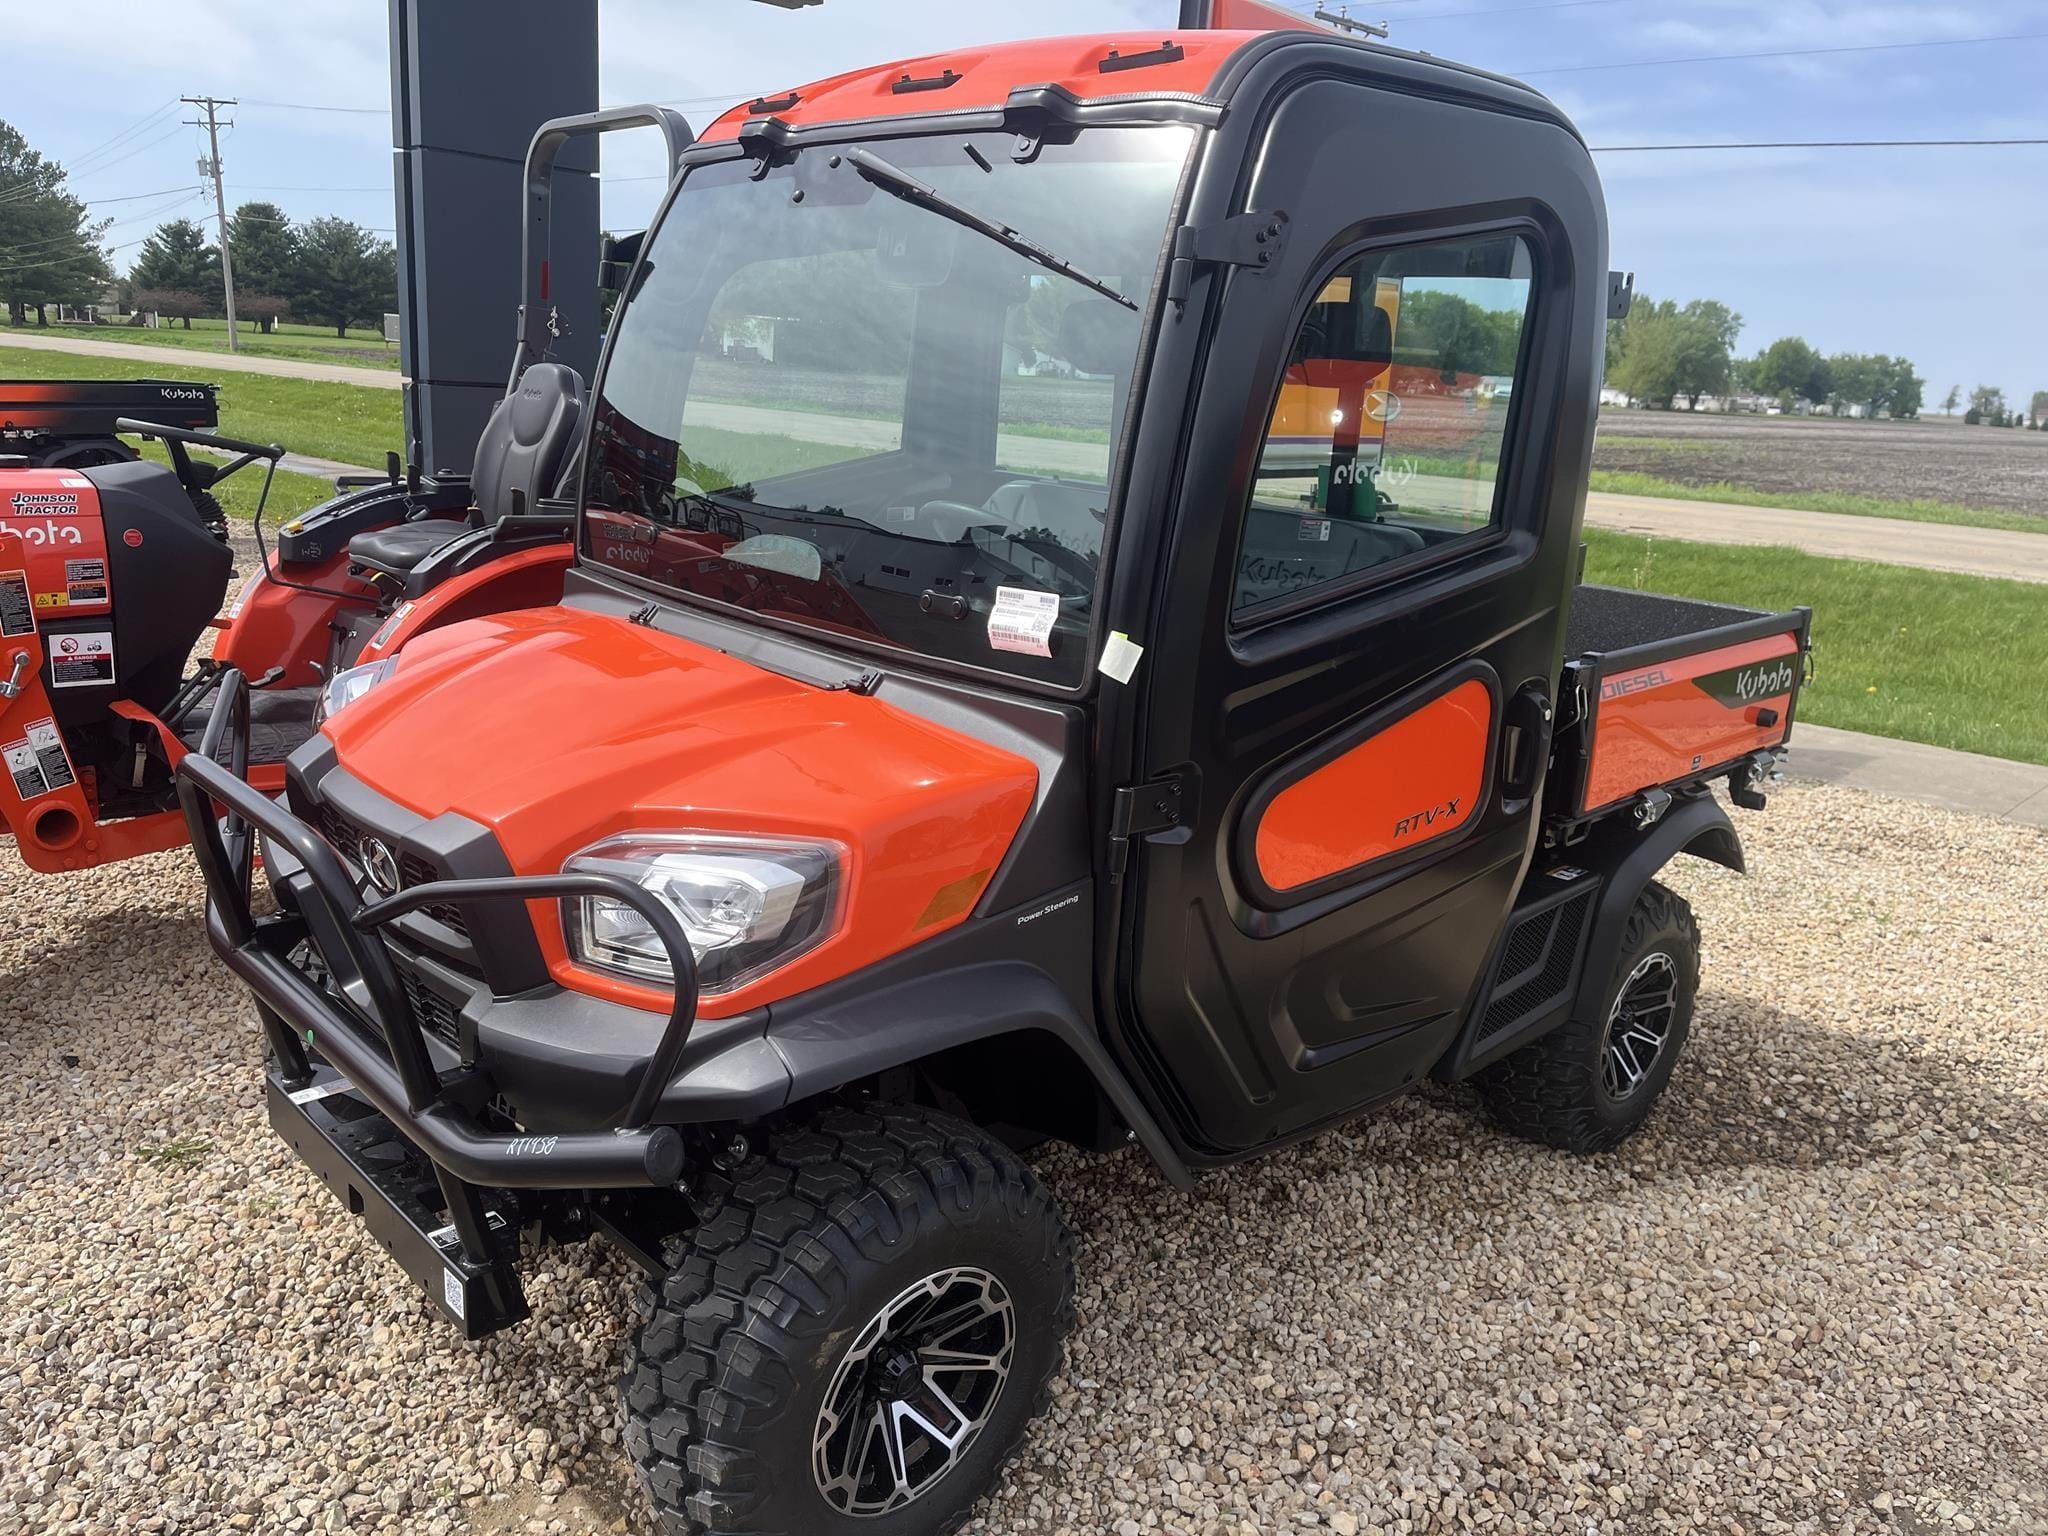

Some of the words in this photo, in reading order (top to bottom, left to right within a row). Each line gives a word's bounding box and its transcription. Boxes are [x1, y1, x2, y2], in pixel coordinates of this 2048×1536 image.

[161, 388, 204, 399] Kubota
[10, 492, 77, 504] JOHNSON
[14, 503, 78, 515] TRACTOR
[1601, 669, 1674, 700] DIESEL
[1736, 661, 1793, 700] Kubota
[1393, 798, 1460, 839] RTV-X
[1017, 909, 1044, 925] Power
[1044, 895, 1079, 914] Steering
[506, 1136, 559, 1156] RT1458
